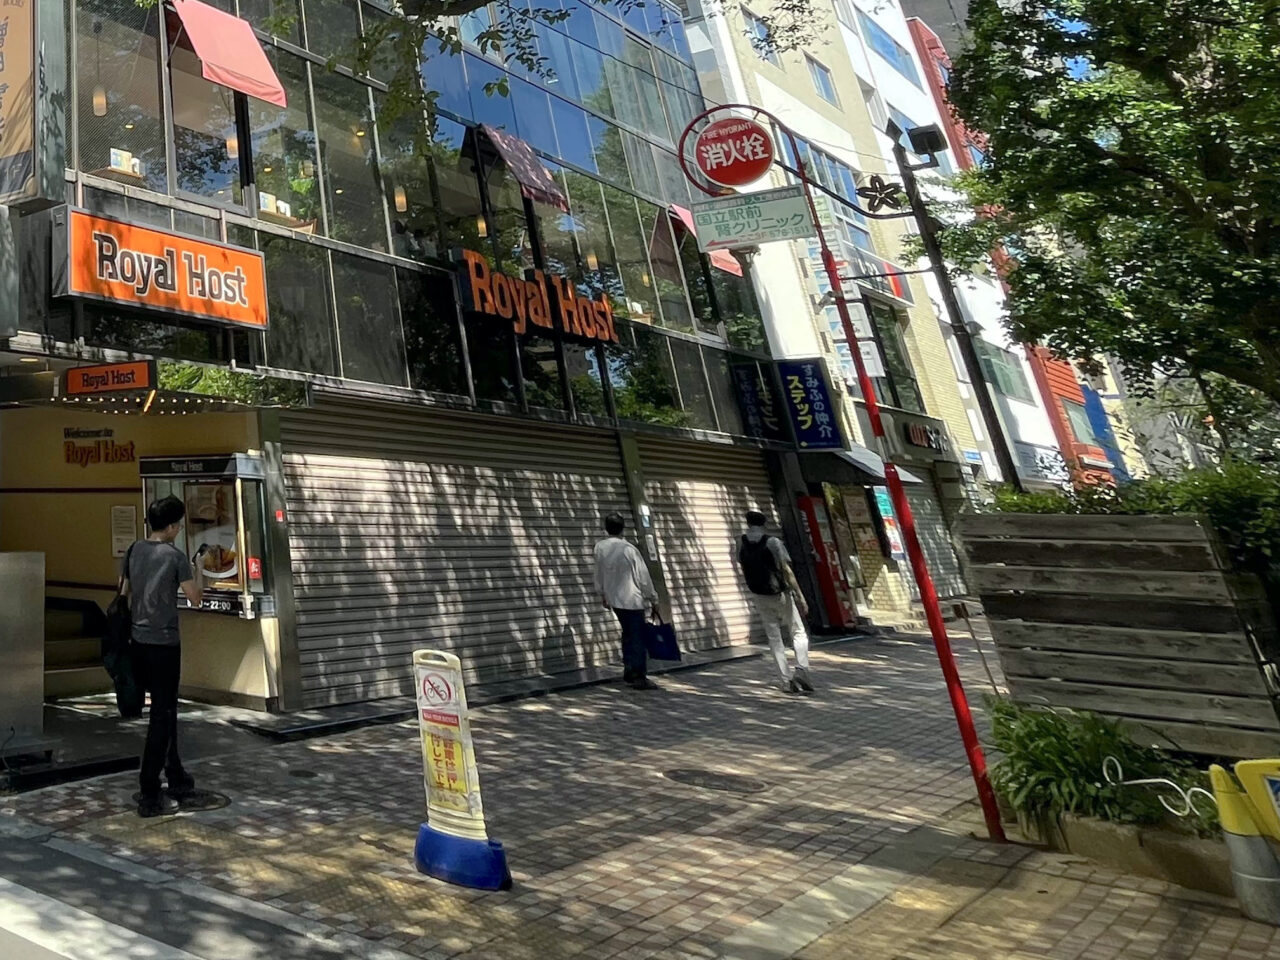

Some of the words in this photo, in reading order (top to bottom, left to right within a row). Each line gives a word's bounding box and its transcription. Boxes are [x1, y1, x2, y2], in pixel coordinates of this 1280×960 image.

[702, 131, 719, 141] FIRE
[719, 121, 752, 136] HYDRANT
[700, 132, 770, 171] 消火栓
[696, 205, 763, 227] 国立駅前
[715, 212, 805, 238] 腎クリニック
[92, 230, 178, 297] Royal
[182, 250, 249, 308] Host
[463, 249, 554, 335] Royal
[550, 274, 620, 344] Host
[82, 373, 109, 390] Royal
[111, 370, 136, 385] Host
[786, 375, 813, 430] ステップ
[801, 363, 833, 438] すみふの仲介
[63, 427, 102, 439] Welcome
[104, 427, 114, 438] to
[63, 441, 101, 468] Royal
[103, 441, 136, 464] Host
